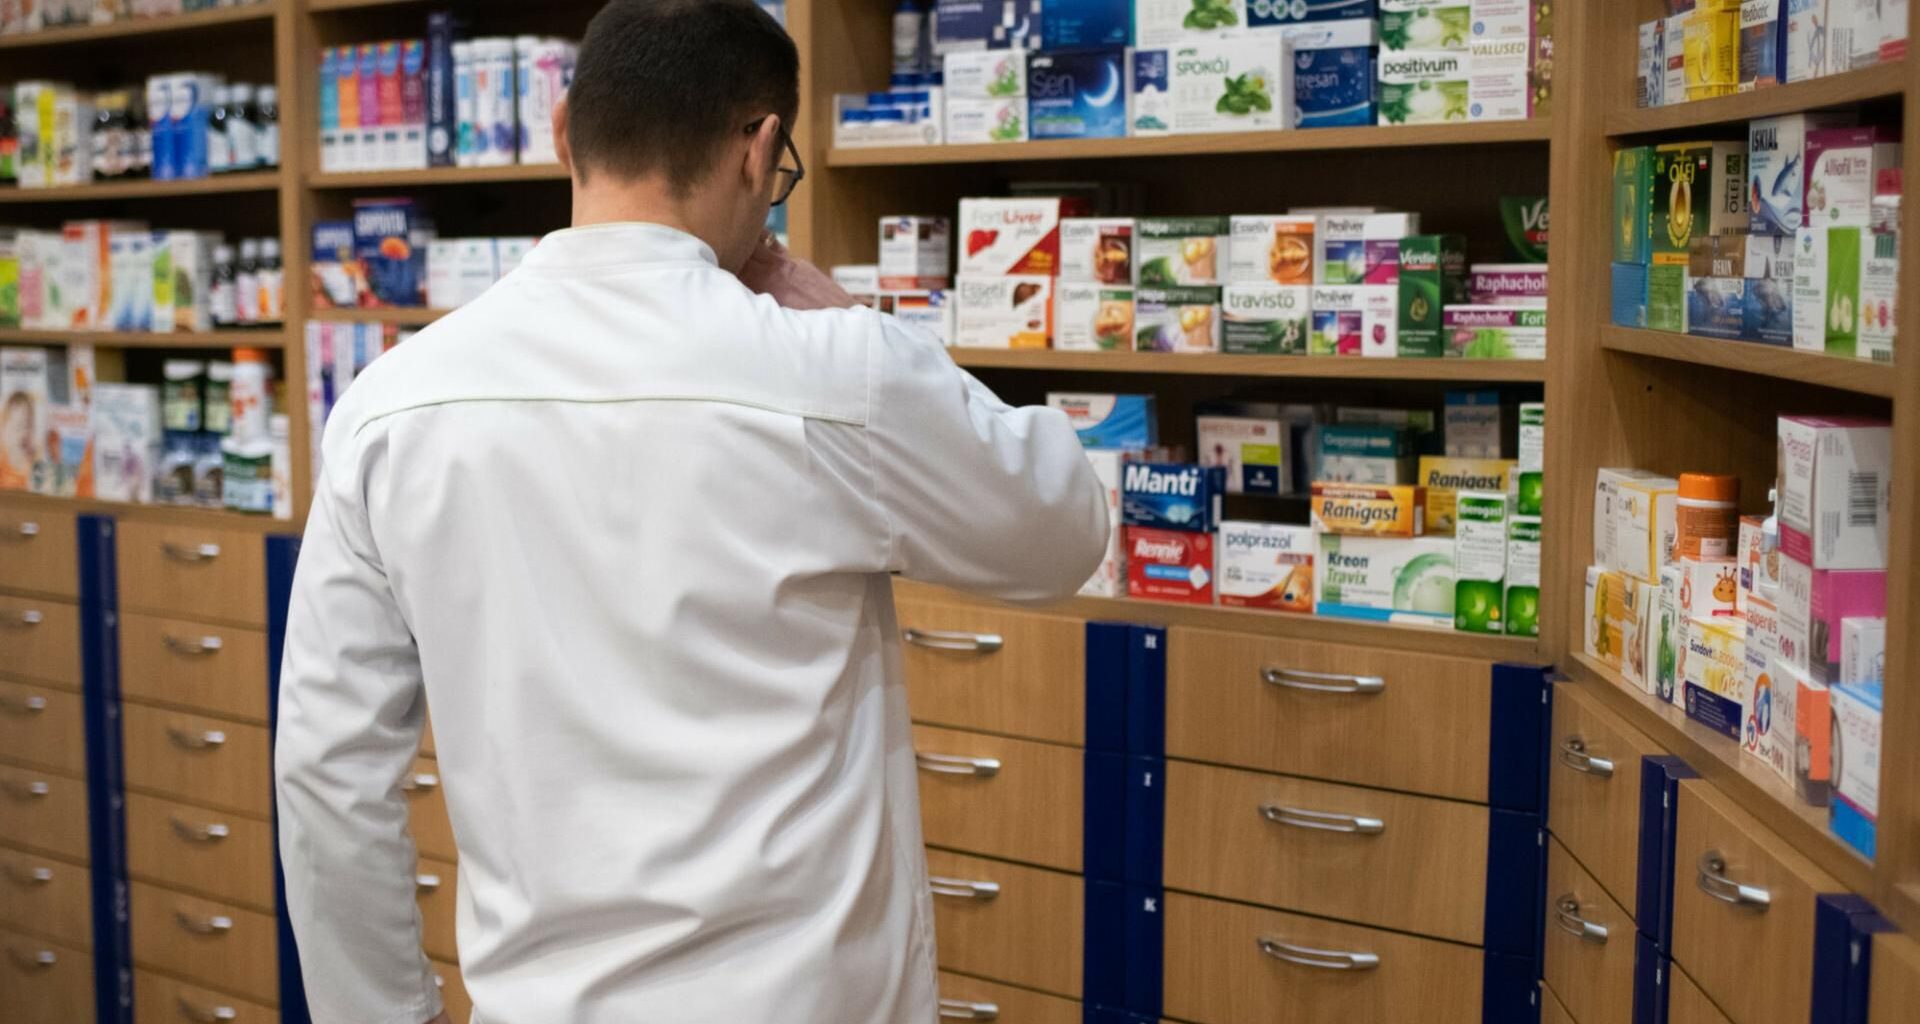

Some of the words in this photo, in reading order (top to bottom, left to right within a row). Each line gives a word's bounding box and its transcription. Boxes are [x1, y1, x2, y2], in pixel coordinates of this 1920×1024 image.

[1471, 41, 1526, 56] VALUSED
[1384, 58, 1458, 78] positivum
[1752, 127, 1778, 152] ISKIAL
[1229, 291, 1296, 310] travisto
[1125, 466, 1199, 496] Manti
[1322, 501, 1399, 525] Ranigast
[1135, 538, 1185, 561] Rennie
[1227, 531, 1292, 549] polprazol
[1328, 552, 1369, 568] Kreon
[1327, 567, 1368, 586] Travix
